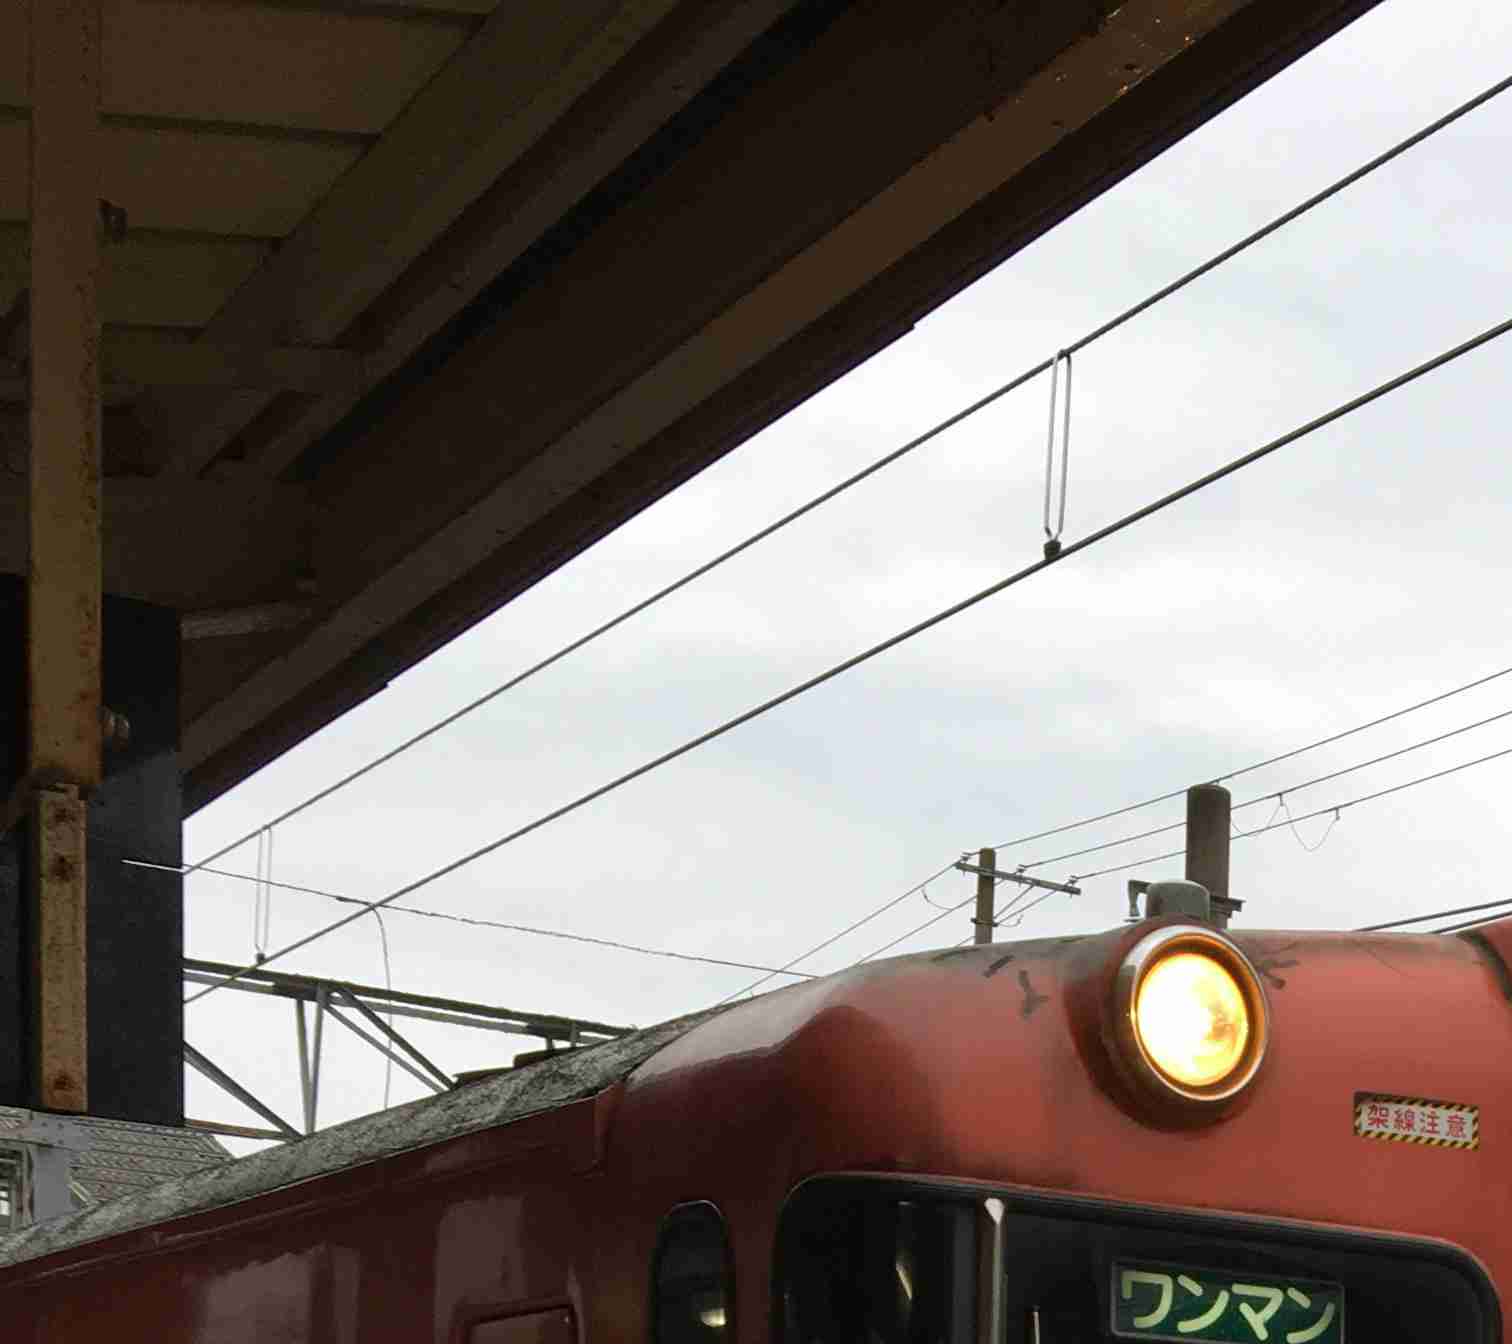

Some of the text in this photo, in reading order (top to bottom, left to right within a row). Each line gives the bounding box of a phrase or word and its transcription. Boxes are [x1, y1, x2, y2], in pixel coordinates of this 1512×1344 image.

[1367, 1103, 1467, 1139] 架線注意
[1120, 1269, 1336, 1344] ワンマン
